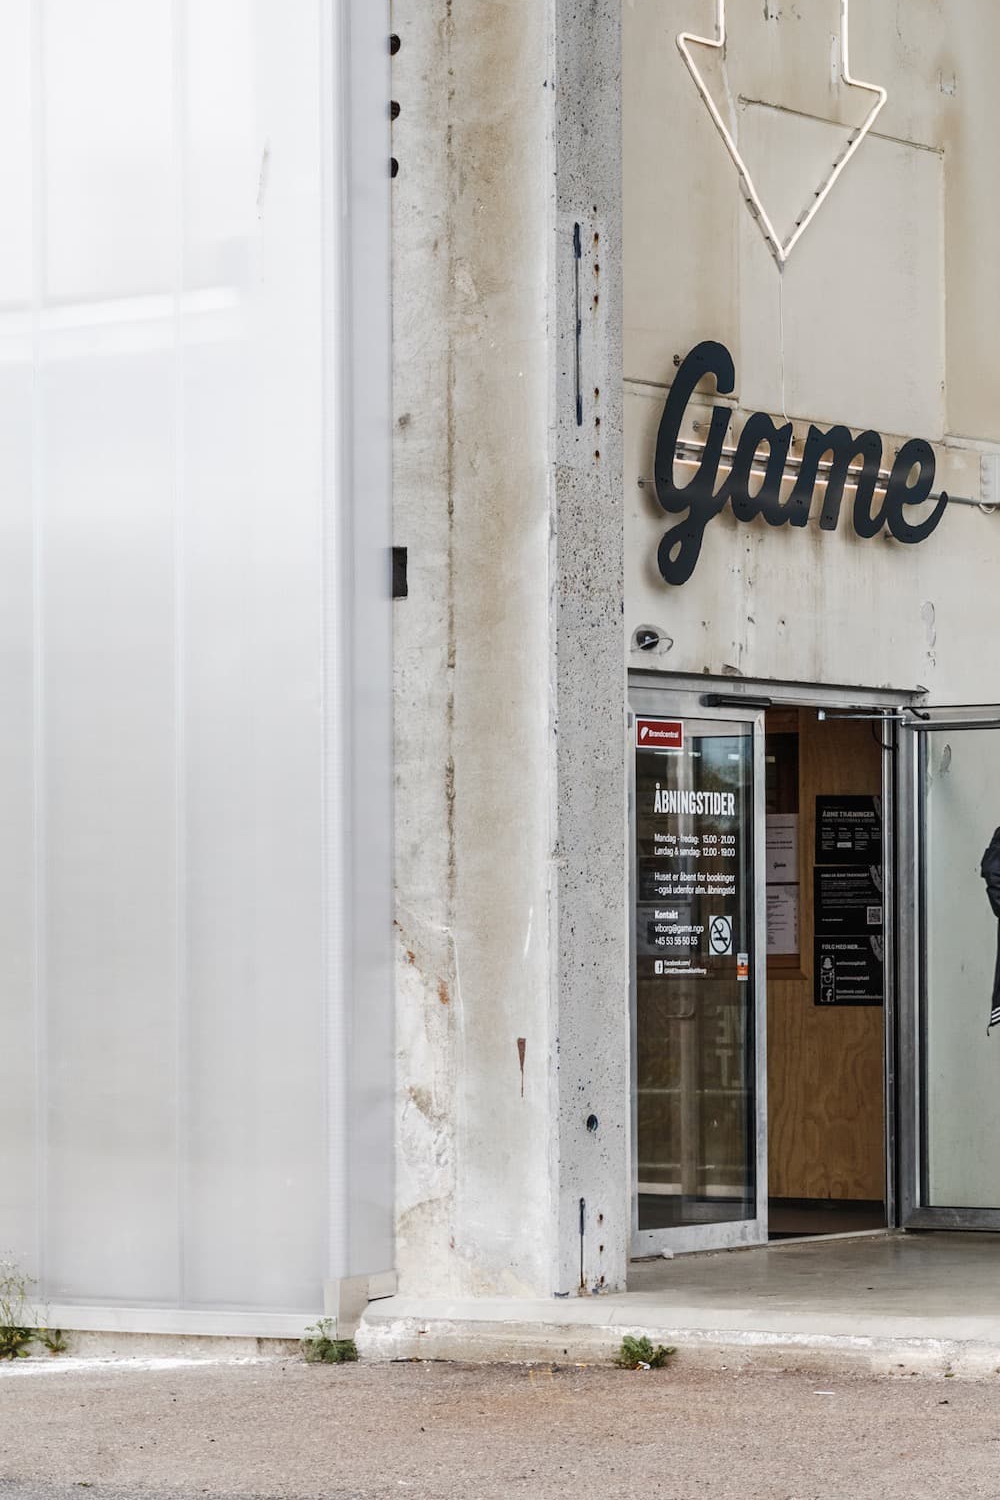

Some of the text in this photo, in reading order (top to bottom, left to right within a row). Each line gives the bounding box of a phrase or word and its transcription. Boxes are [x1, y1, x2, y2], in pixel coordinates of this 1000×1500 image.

[654, 340, 948, 586] Game
[654, 782, 735, 816] ÅBNINGSTIDER
[654, 910, 679, 919] Kontakt
[654, 923, 704, 934] viborg@game.ngo
